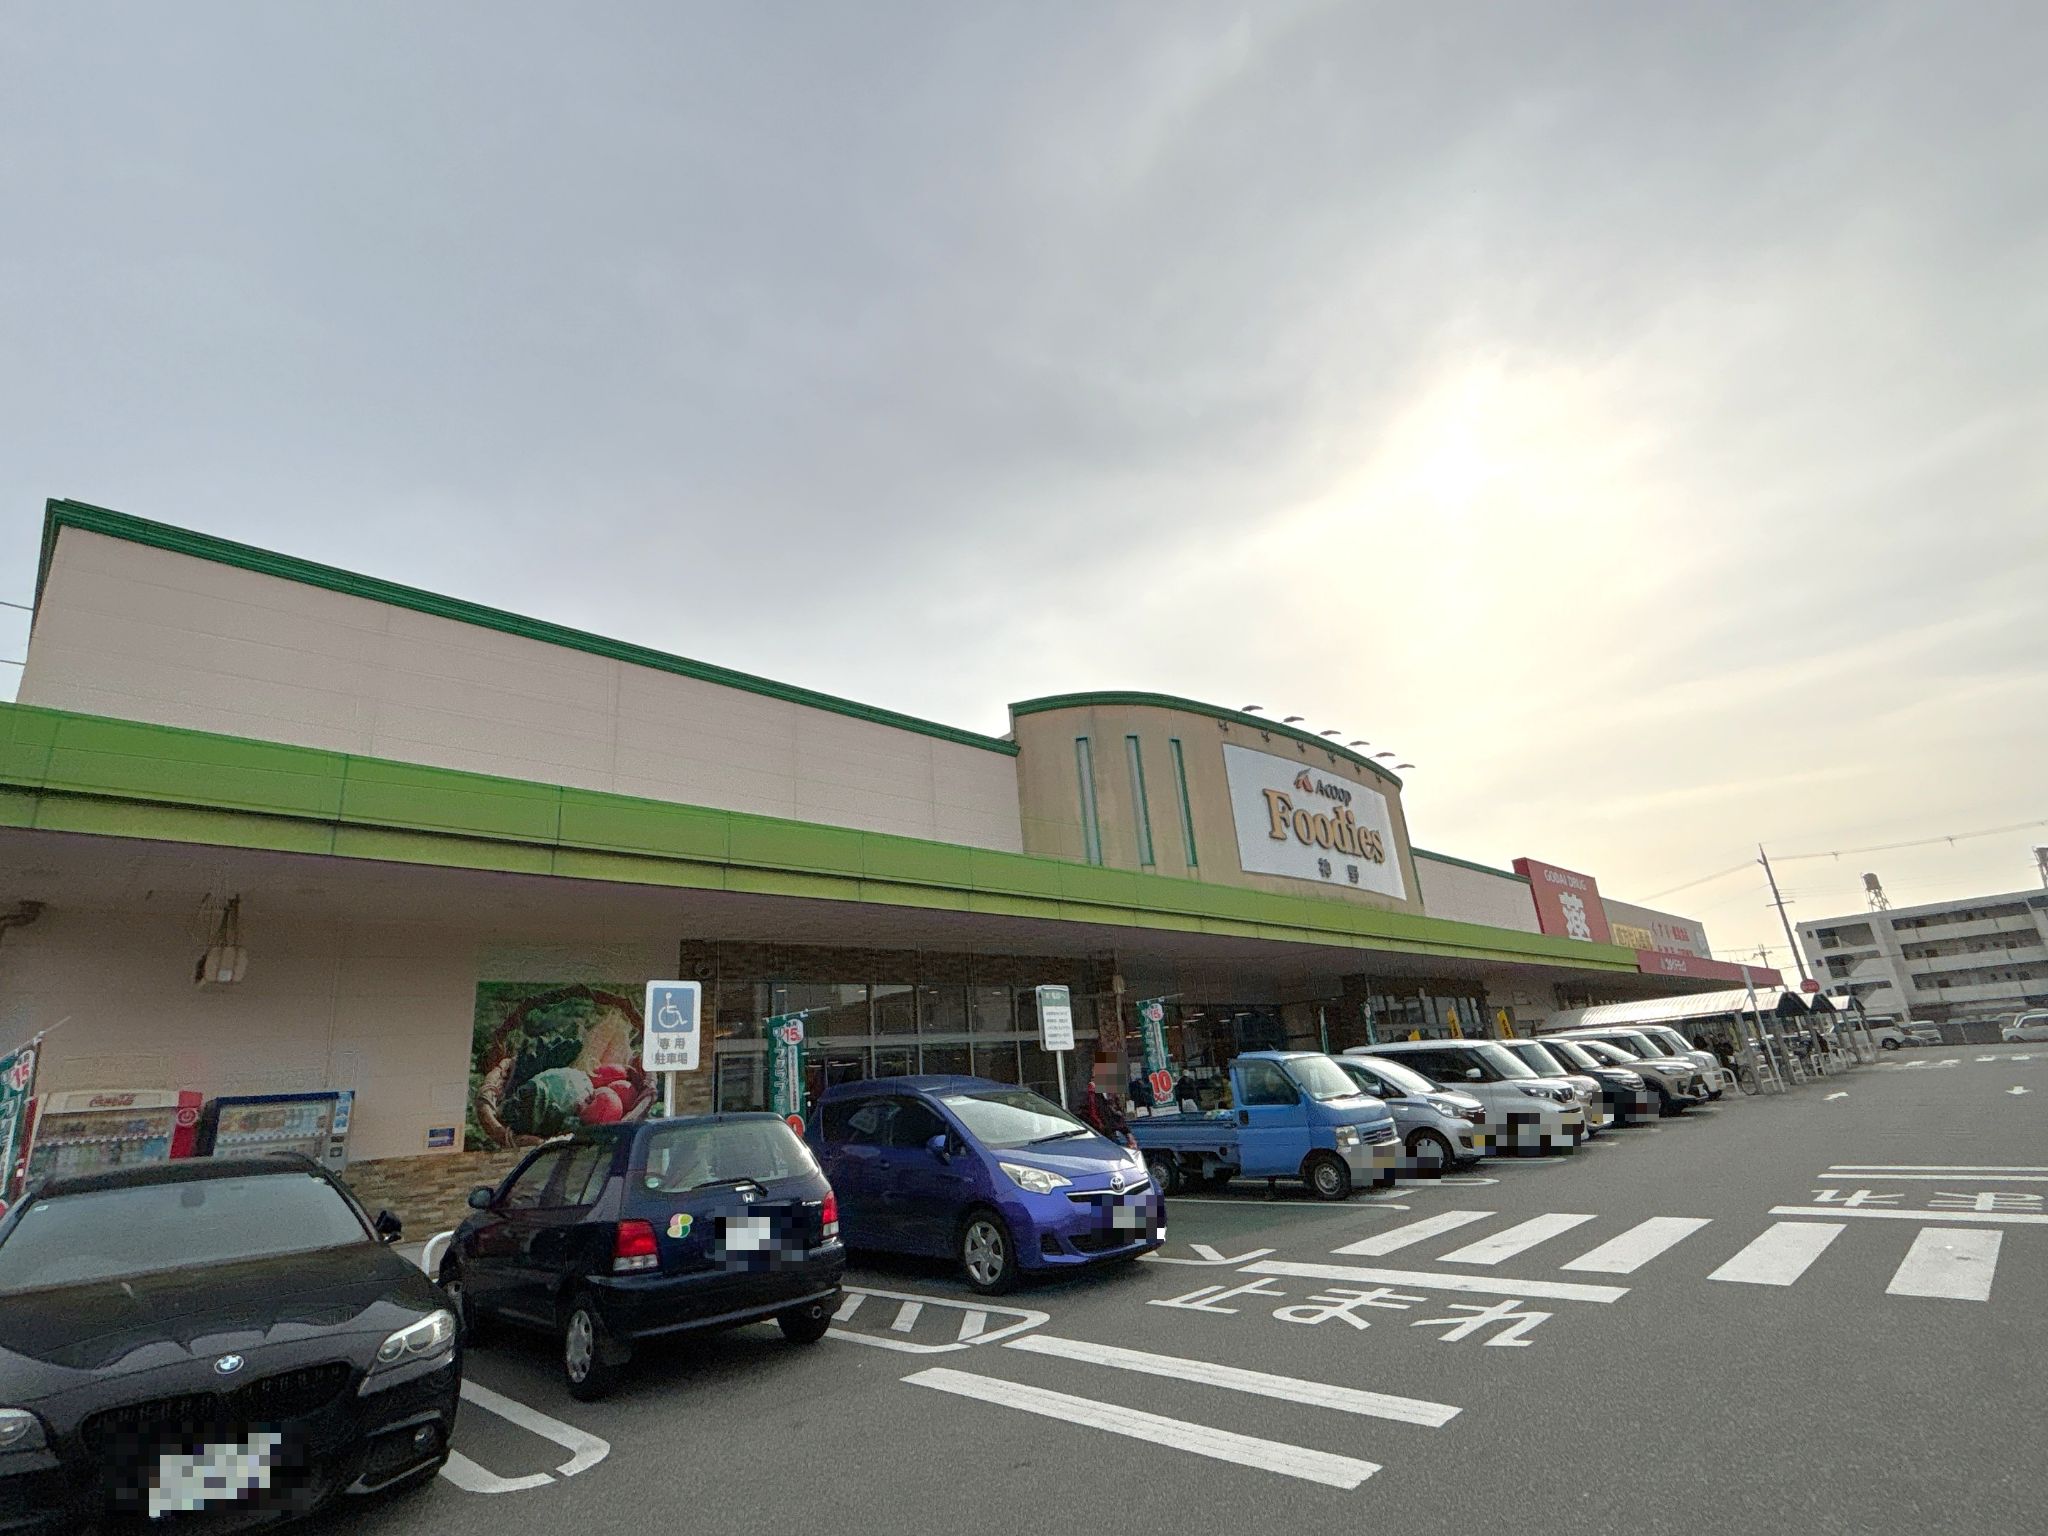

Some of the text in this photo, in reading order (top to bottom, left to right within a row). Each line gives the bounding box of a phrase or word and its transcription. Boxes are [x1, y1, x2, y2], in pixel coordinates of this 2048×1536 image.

[1262, 788, 1386, 865] Foodies
[659, 1038, 686, 1050] 専用
[654, 1051, 688, 1065] 駐車場
[1149, 1070, 1173, 1094] 10
[1146, 1277, 1554, 1347] 止まれ
